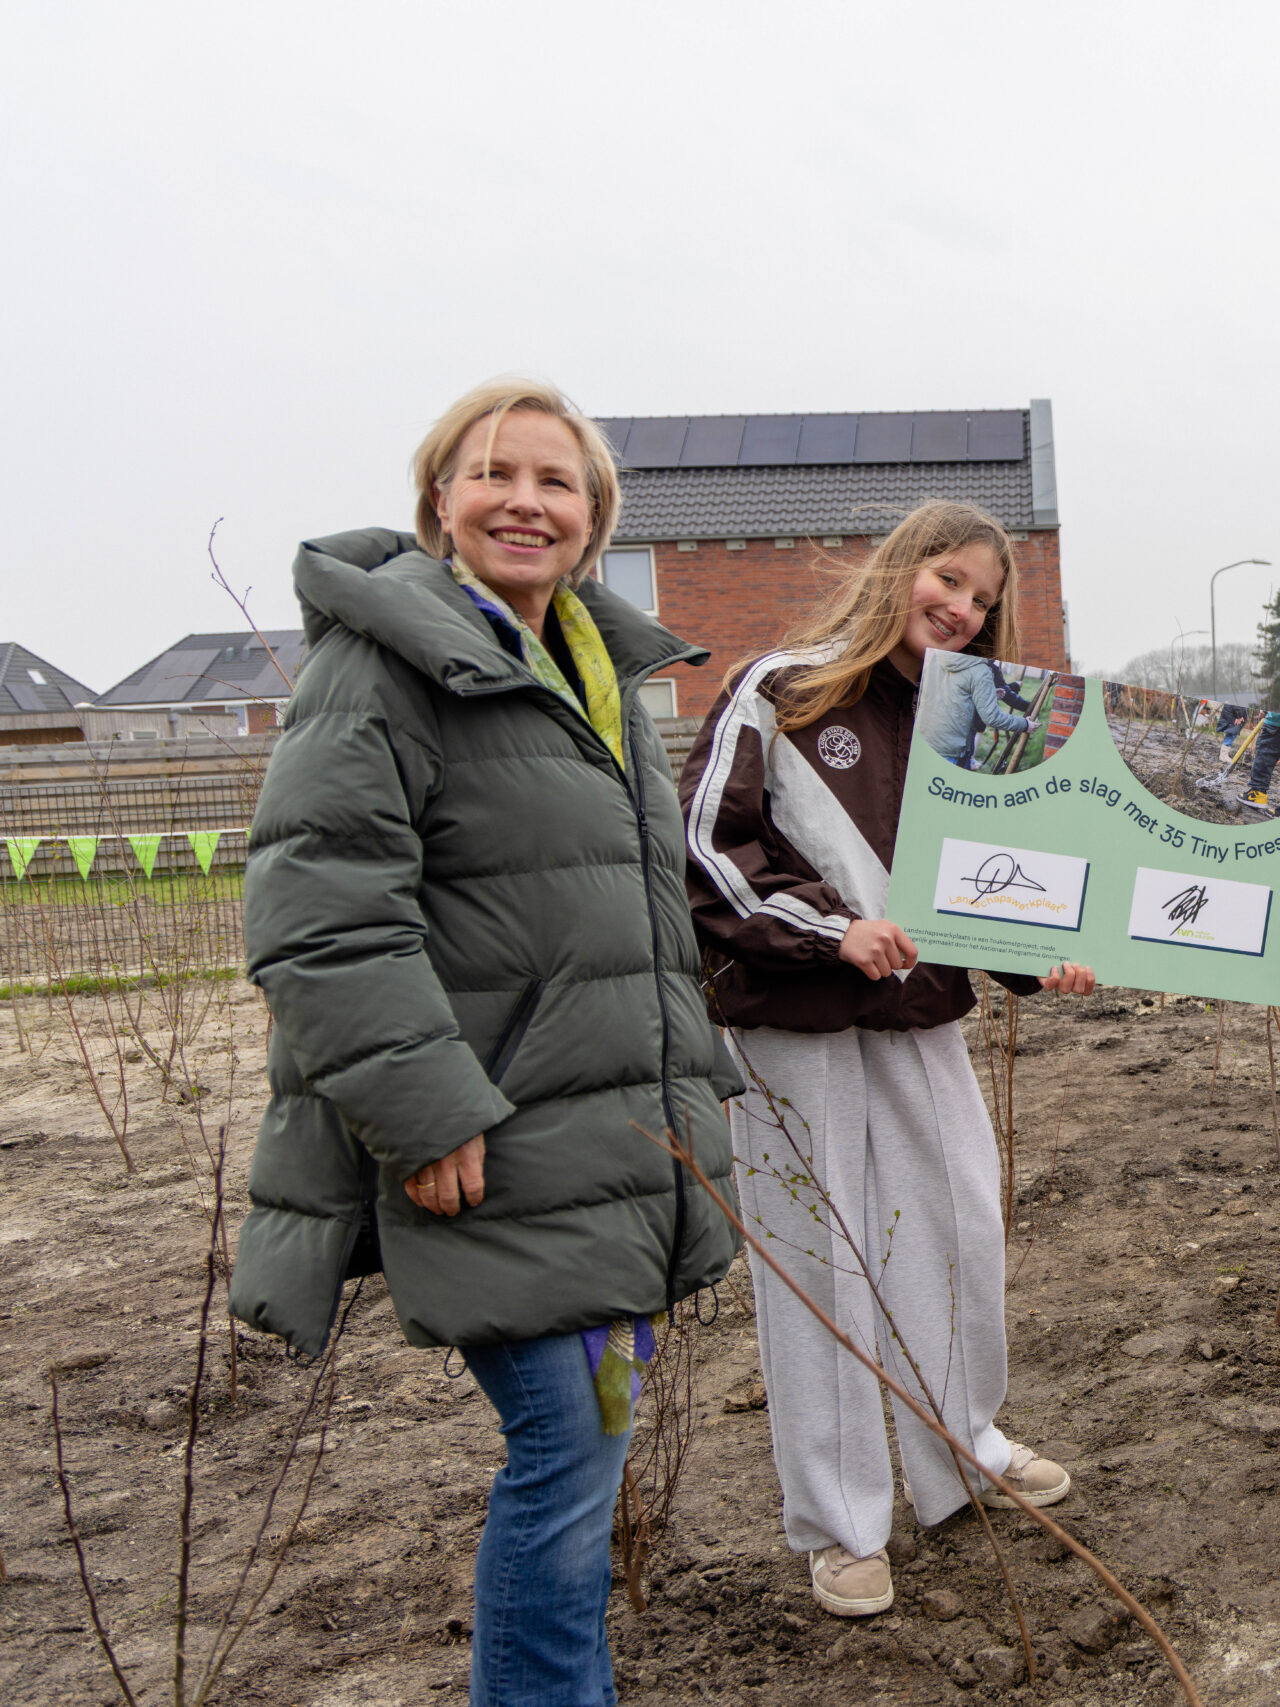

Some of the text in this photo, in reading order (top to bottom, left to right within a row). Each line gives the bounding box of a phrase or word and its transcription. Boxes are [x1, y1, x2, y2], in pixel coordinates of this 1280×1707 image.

[928, 777, 997, 808] Samen
[1004, 786, 1040, 807] aan
[1045, 776, 1072, 795] de
[1079, 777, 1121, 807] slag
[1123, 801, 1158, 834] met
[1159, 824, 1187, 848] 35
[1191, 836, 1228, 863] Tiny
[903, 927, 971, 941] Landschapswerkplaats
